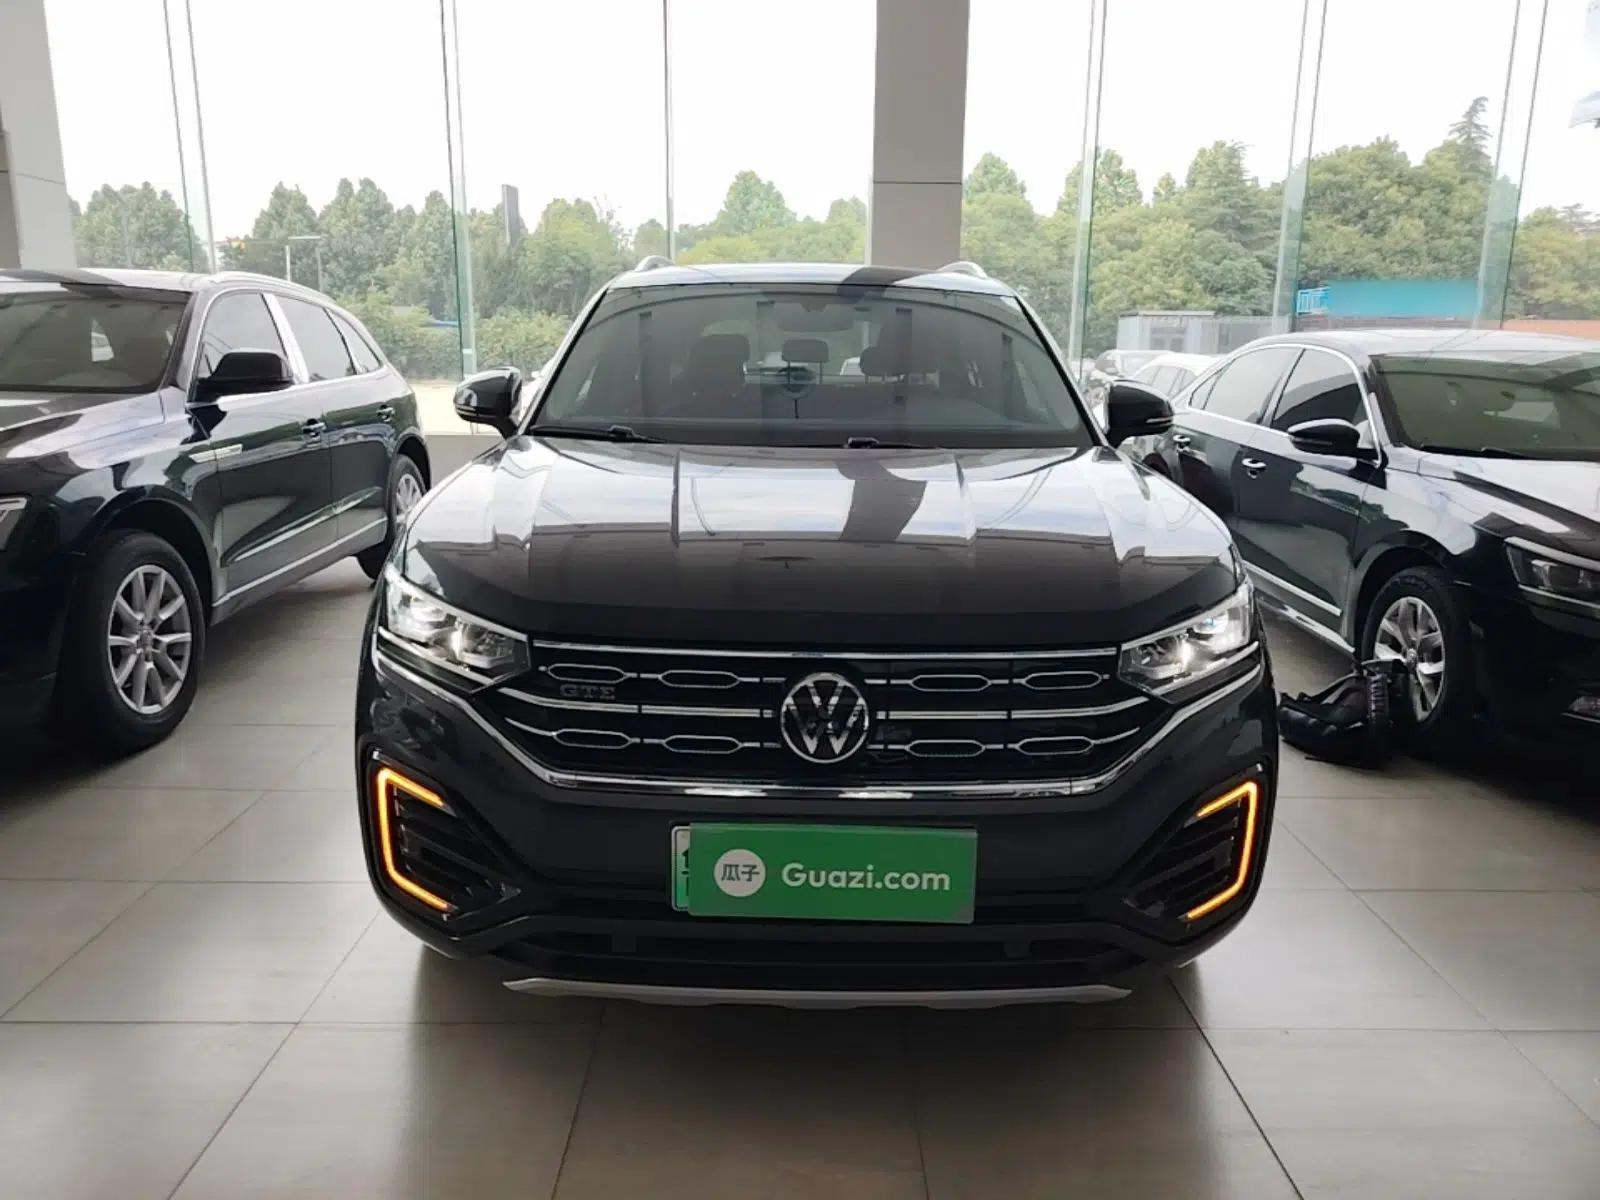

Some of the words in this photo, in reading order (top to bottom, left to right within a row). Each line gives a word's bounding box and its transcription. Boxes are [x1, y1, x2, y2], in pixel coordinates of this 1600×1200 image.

[560, 684, 615, 699] GTE
[721, 863, 760, 882] 瓜子
[781, 862, 951, 890] Guazi.com
